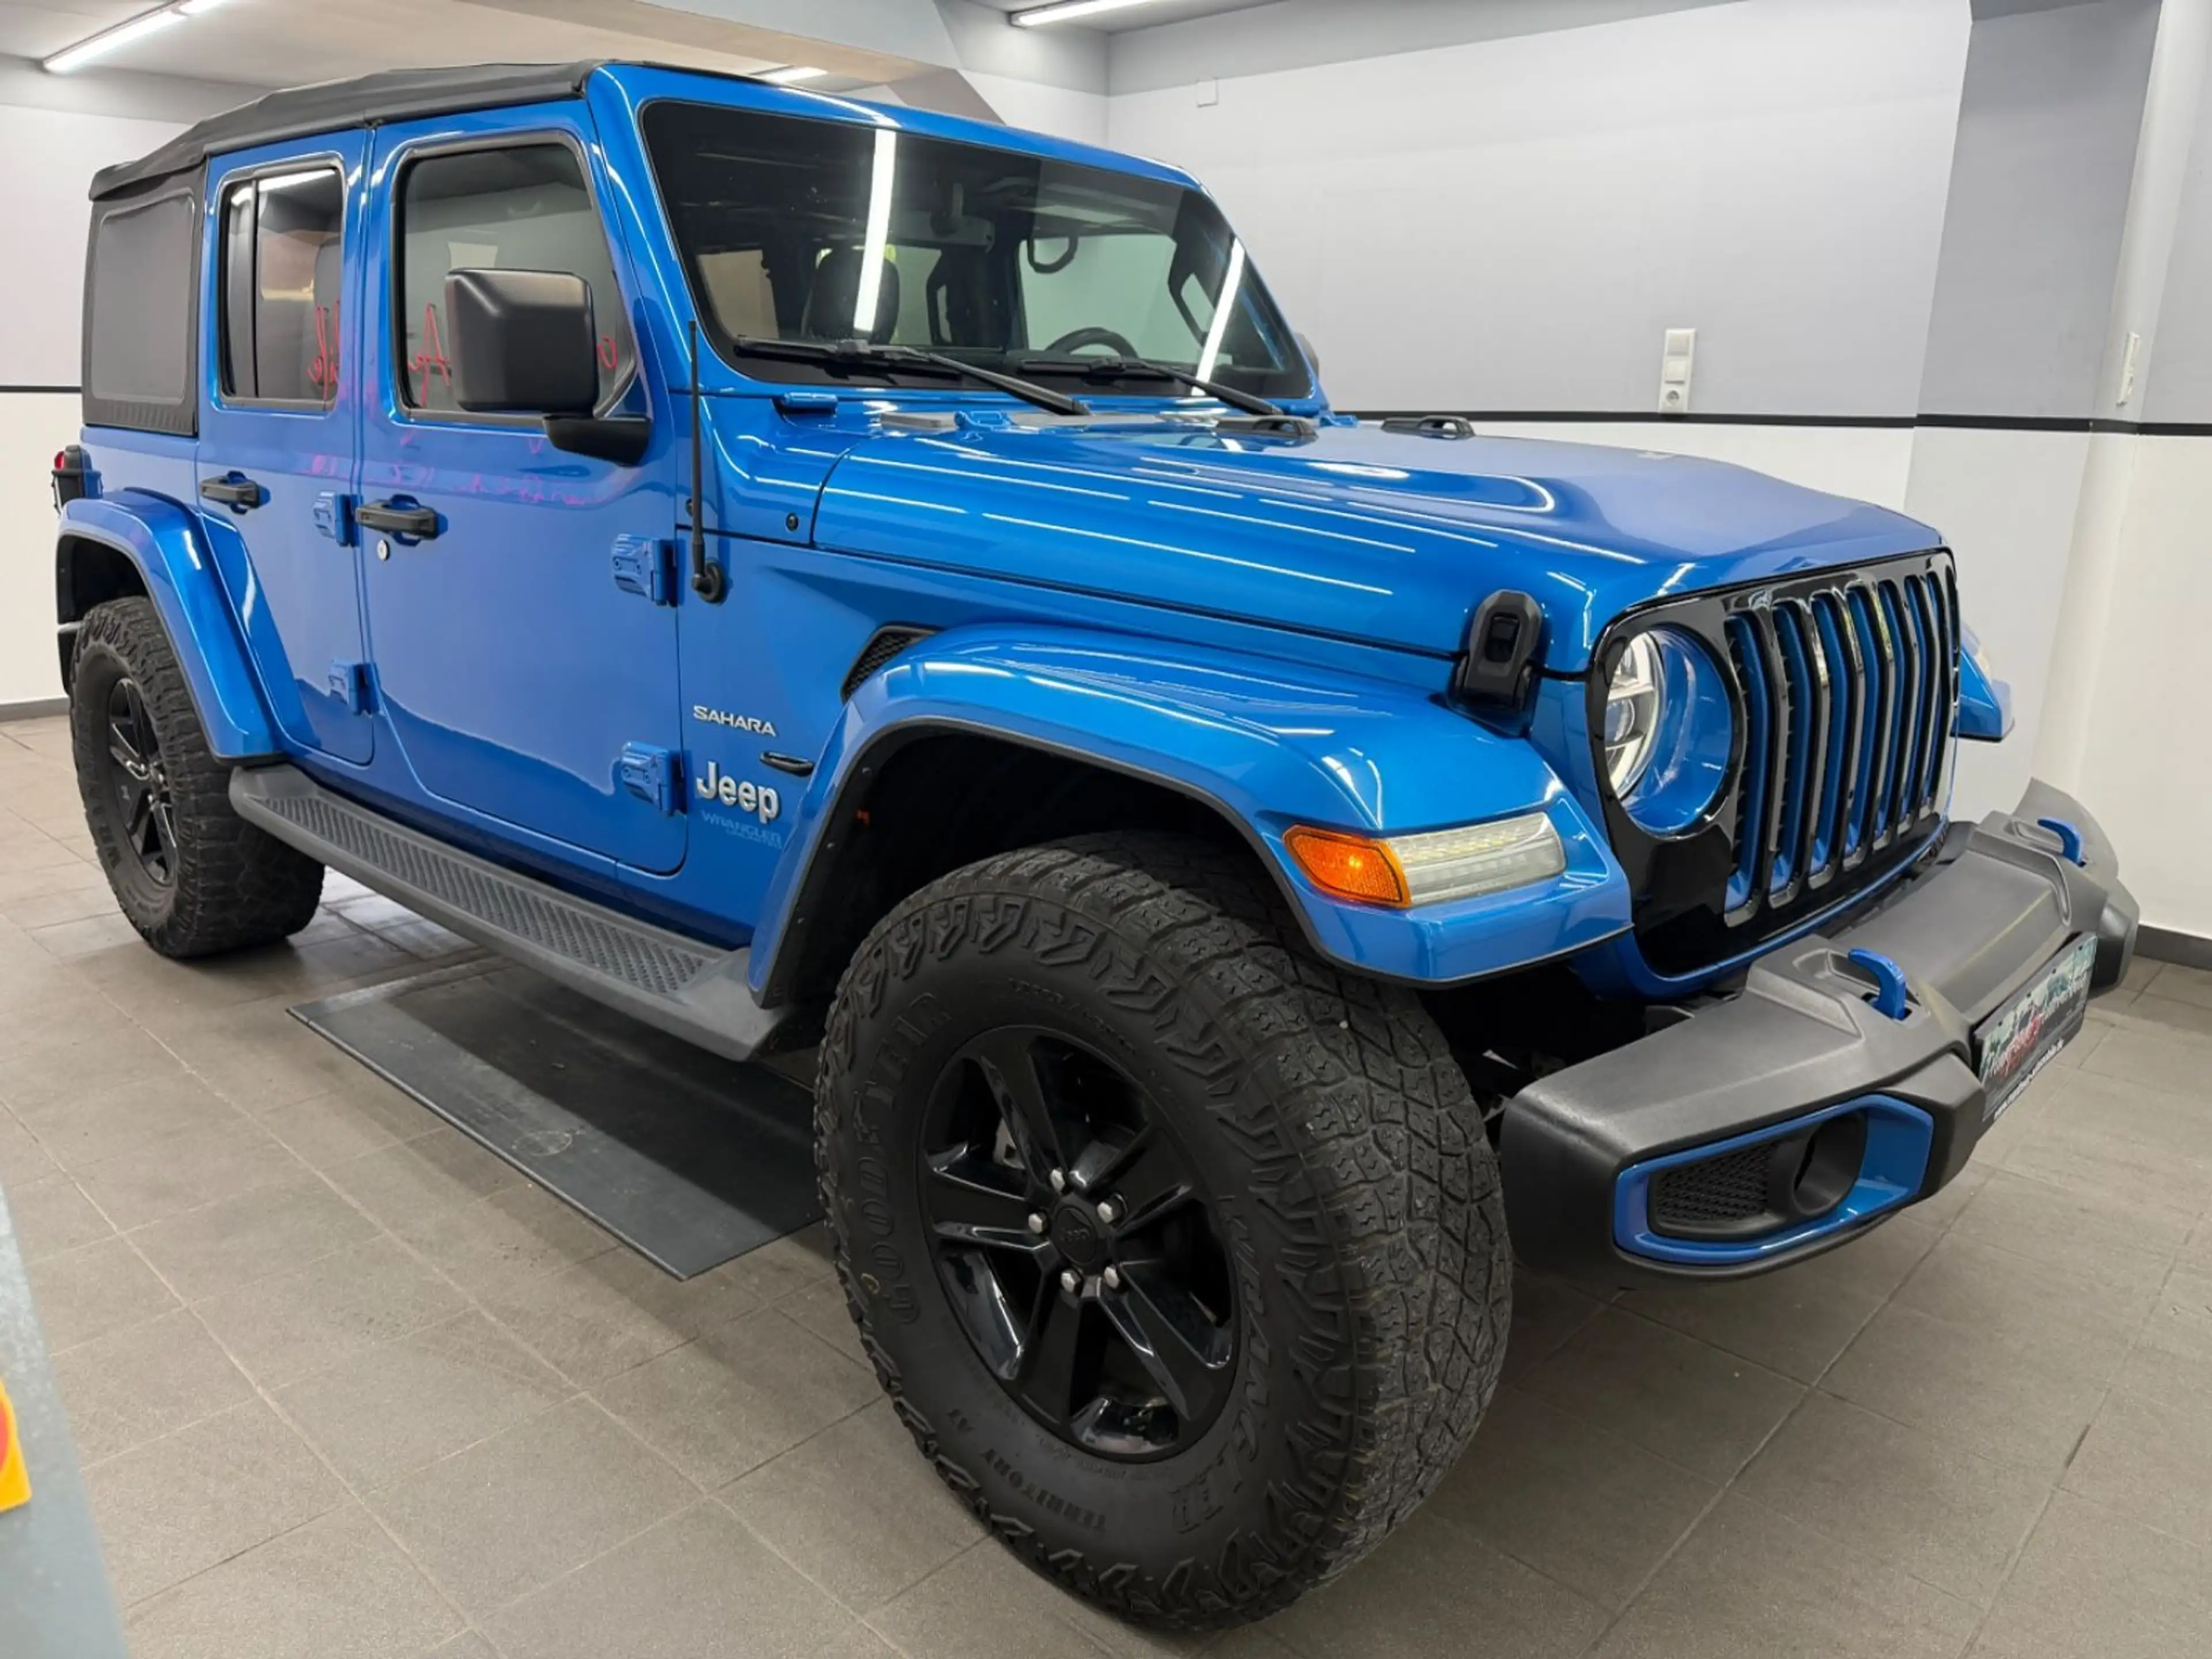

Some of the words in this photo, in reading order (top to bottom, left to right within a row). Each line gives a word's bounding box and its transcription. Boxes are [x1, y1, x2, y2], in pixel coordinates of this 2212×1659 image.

[693, 704, 777, 737] SAHARA
[696, 761, 779, 824] Jeep
[982, 1445, 1107, 1529] TERRITORY
